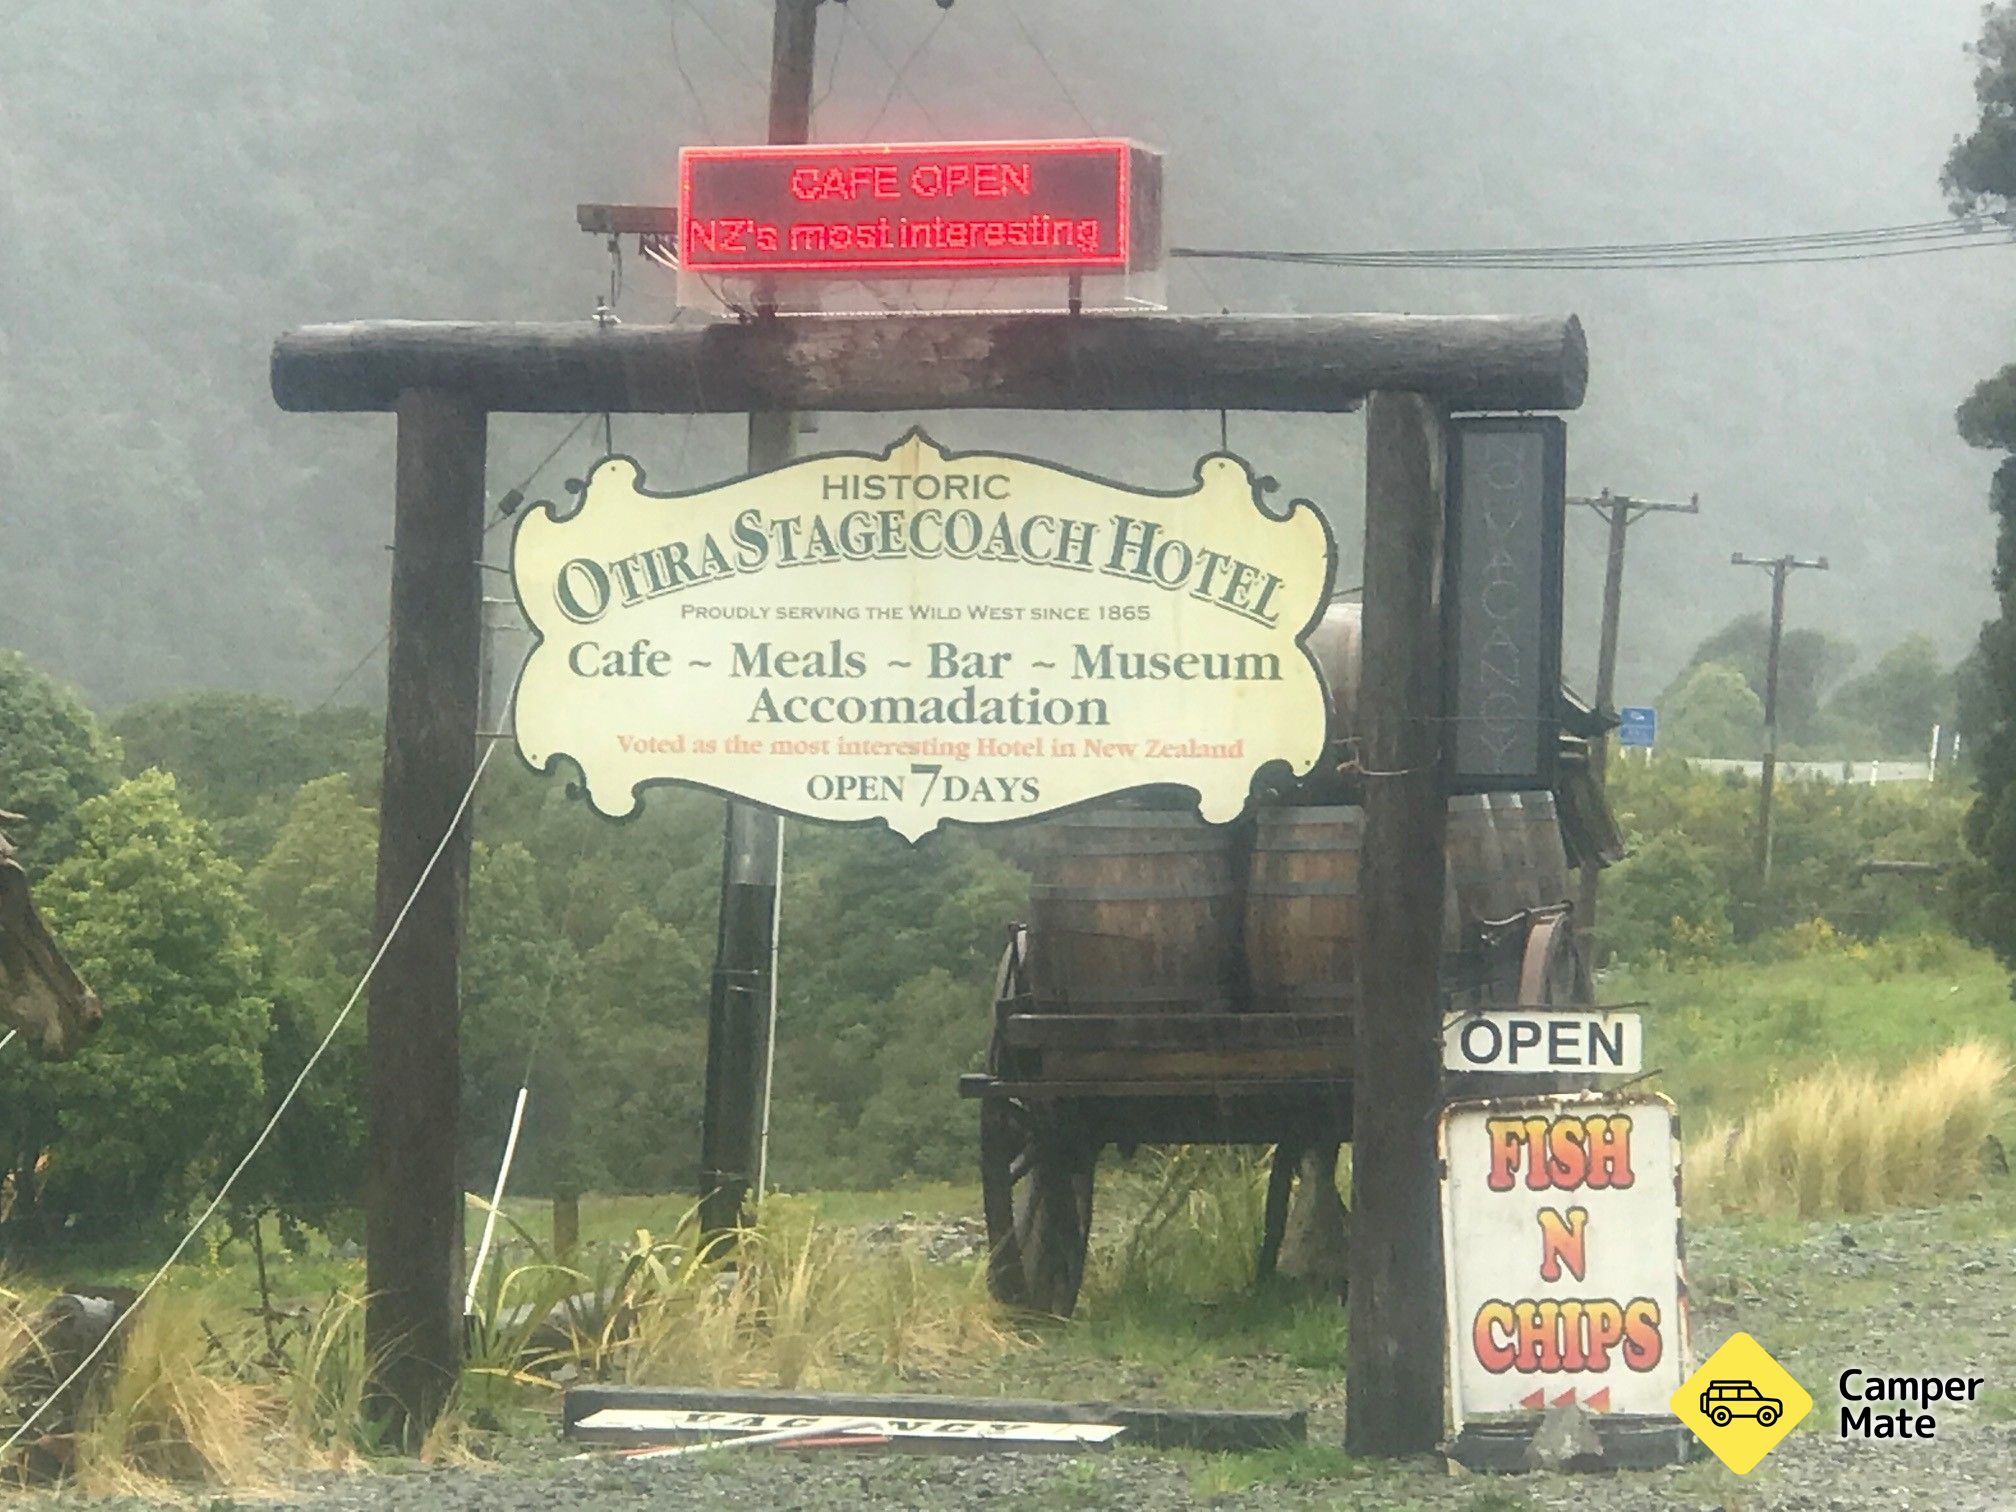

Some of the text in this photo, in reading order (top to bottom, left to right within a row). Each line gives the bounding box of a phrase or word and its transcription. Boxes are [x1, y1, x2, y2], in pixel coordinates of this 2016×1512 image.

[791, 162, 1032, 201] CAFE OPEN
[689, 214, 1099, 254] NZ's most interesting
[822, 474, 1011, 500] HISTORIC
[554, 507, 1285, 629] OTIRA STAGECOACH HOTEL
[681, 604, 1150, 621] PROUDLY SERVING THE WILD WEST SINCE 1865
[568, 639, 671, 678] Cafe
[730, 639, 867, 679] Meals
[927, 642, 1012, 680] Bar
[1070, 643, 1283, 681] Museum
[747, 686, 1110, 726] Accomadation
[617, 734, 1244, 761] Voted as the most interesting Hotel in New Zealand
[806, 763, 1040, 807] OPEN 7 DAYS
[1460, 1019, 1624, 1067] OPEN
[1485, 1113, 1635, 1192] FISH
[1536, 1205, 1589, 1284] N
[1473, 1296, 1663, 1374] CHIPS
[686, 1413, 1030, 1434] VACNCY
